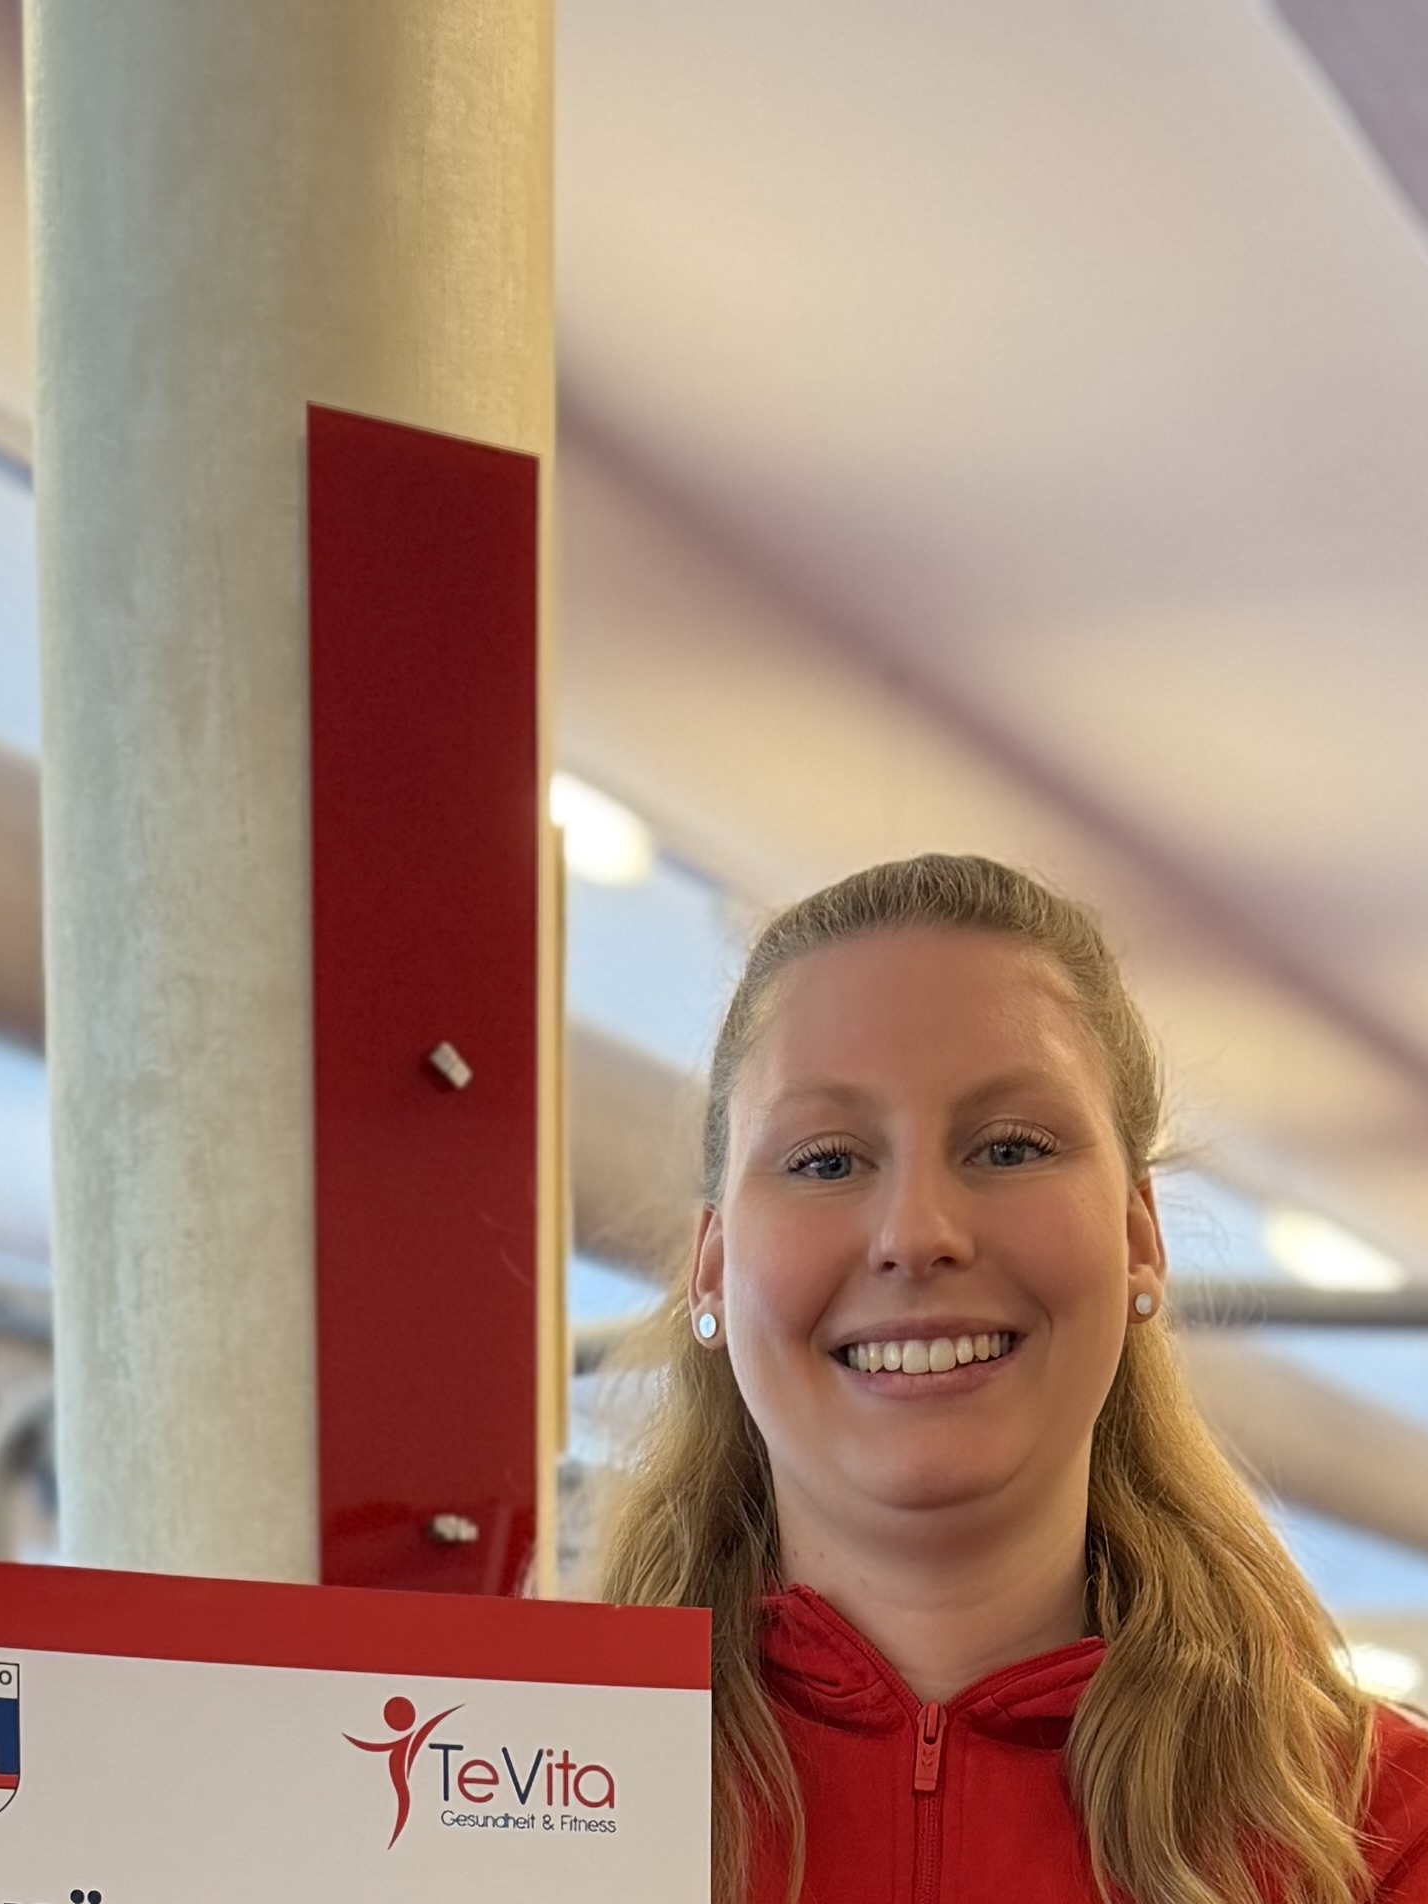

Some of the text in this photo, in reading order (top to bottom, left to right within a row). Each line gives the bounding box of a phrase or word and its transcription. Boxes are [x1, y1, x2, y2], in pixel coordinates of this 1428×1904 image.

[429, 1743, 615, 1808] TeVita
[441, 1810, 616, 1833] Gesundheit & Fitness
